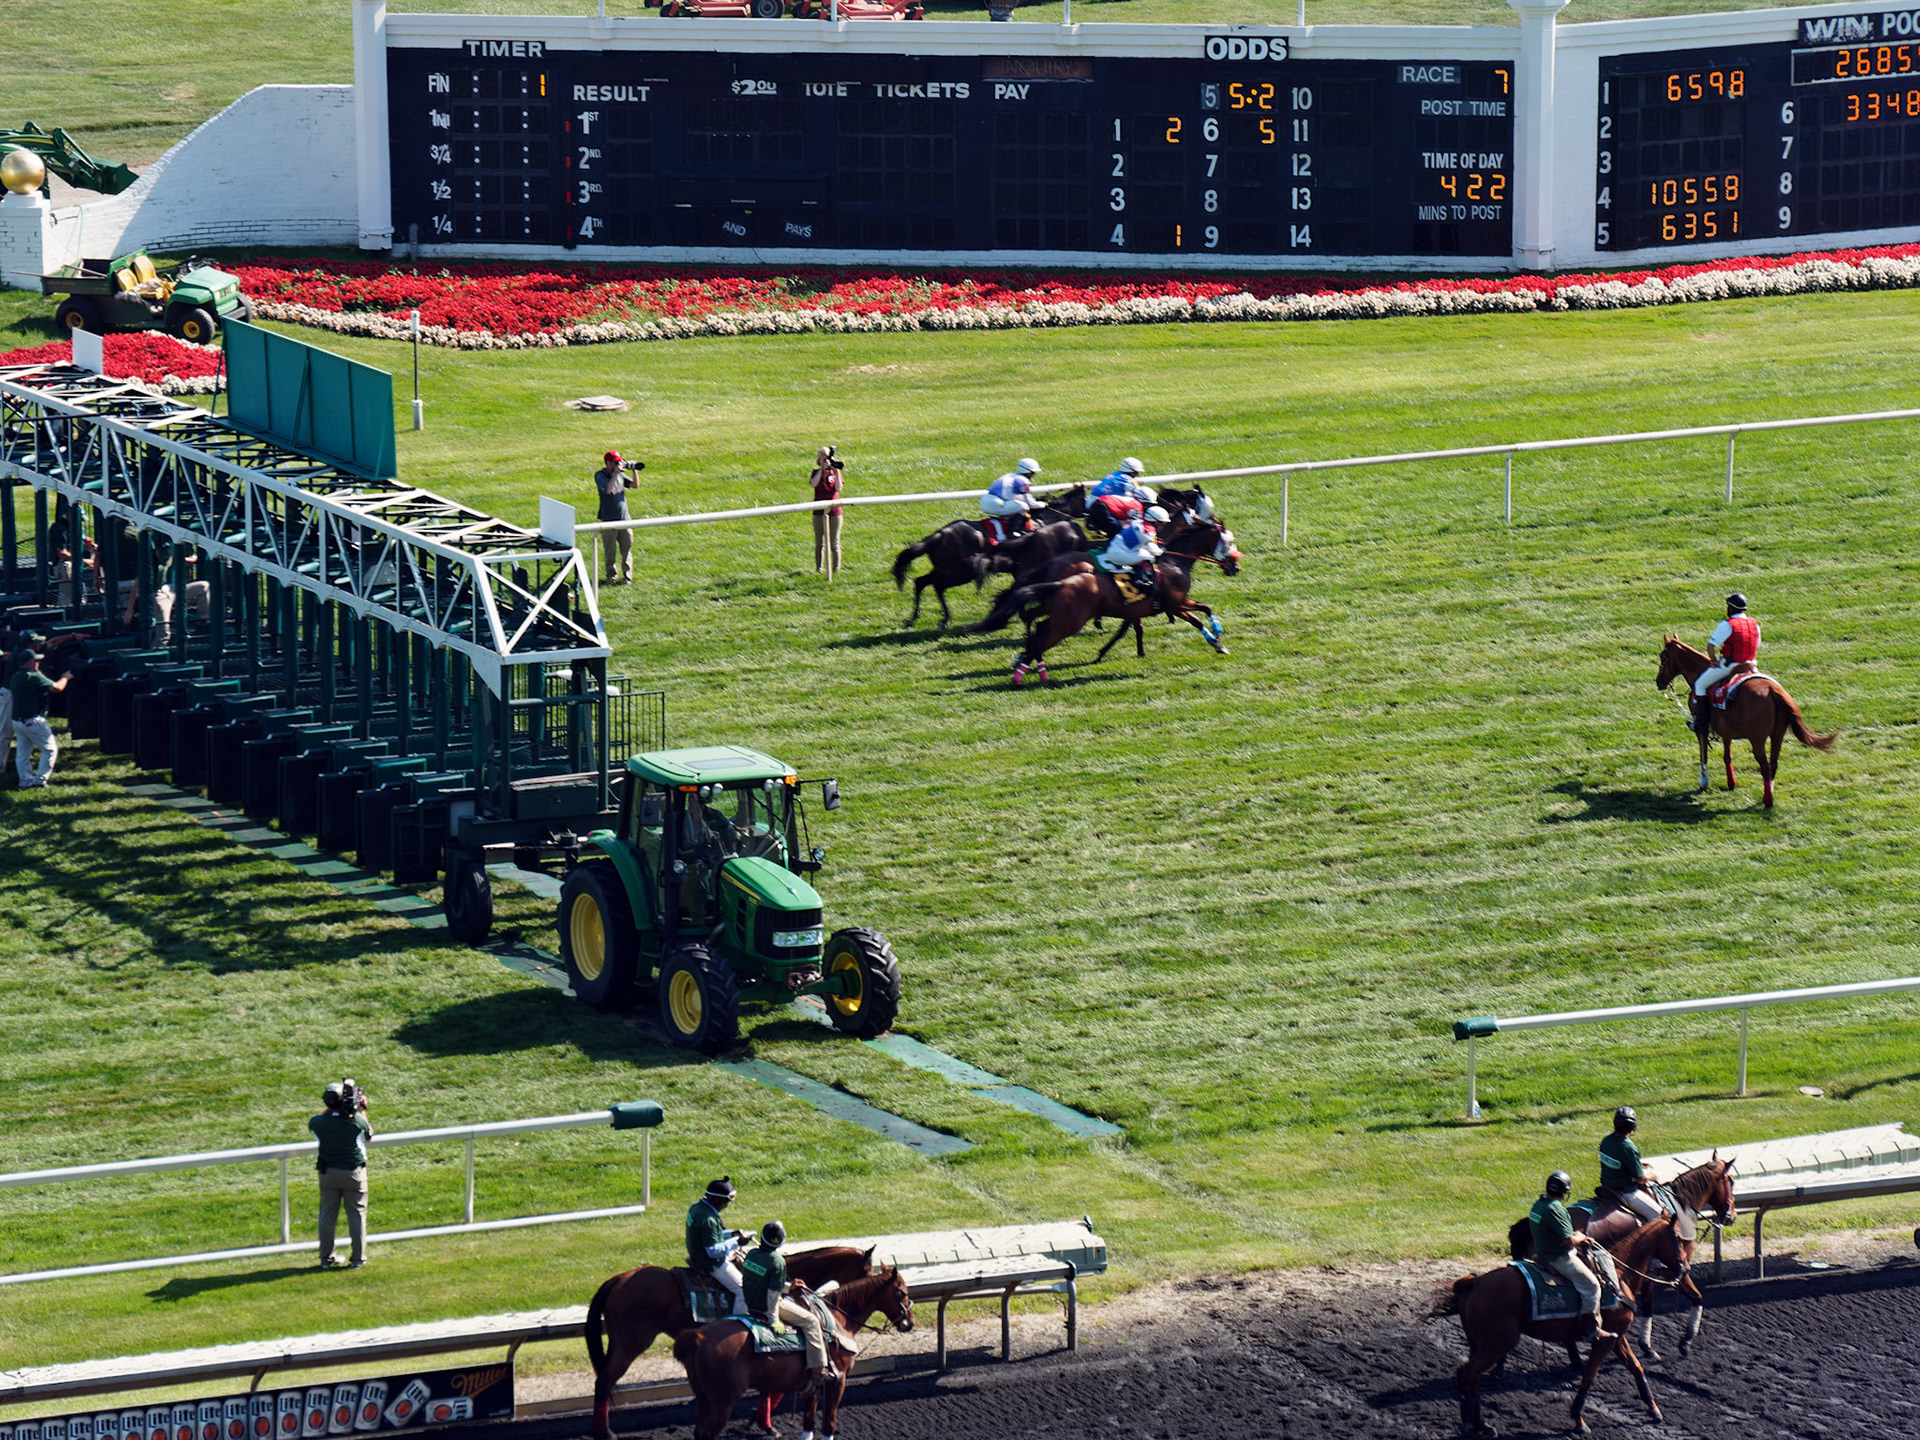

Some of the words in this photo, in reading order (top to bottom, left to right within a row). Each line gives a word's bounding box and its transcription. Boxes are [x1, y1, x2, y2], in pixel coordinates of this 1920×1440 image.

[1805, 15, 1870, 38] WIN
[466, 40, 543, 57] TIMER
[1206, 38, 1287, 61] ODDS
[1836, 46, 1920, 76] 2685
[429, 73, 449, 92] FIN
[1403, 67, 1454, 82] RACE
[1496, 70, 1508, 93] 7
[1604, 82, 1609, 104] 1
[1668, 71, 1744, 101] 6598
[574, 85, 650, 101] RESULT
[873, 83, 969, 98] TICKETS
[995, 84, 1029, 99] PAY
[1205, 85, 1217, 107] 5
[1292, 87, 1312, 109] 10
[1422, 100, 1462, 115] POST
[1470, 101, 1505, 116] TIME
[1782, 102, 1793, 123] 6
[1114, 119, 1120, 141] 1
[1167, 117, 1181, 142] 2
[1204, 118, 1218, 141] 6
[1260, 120, 1274, 143] 5
[1293, 119, 1308, 141] 11
[1600, 117, 1611, 139] 2
[1782, 137, 1793, 159] 7
[1112, 154, 1123, 176] 2
[1206, 155, 1218, 177] 7
[1292, 154, 1311, 176] 12
[1422, 153, 1457, 168] TIME
[1460, 153, 1476, 168] OF
[1479, 153, 1503, 168] DAY
[1600, 151, 1611, 173] 3
[431, 180, 451, 200] 1/2
[1598, 186, 1611, 209] 4
[1652, 176, 1738, 205] 10558
[1780, 172, 1792, 194] 8
[1111, 188, 1125, 211] 3
[1205, 190, 1217, 212] 8
[1292, 188, 1311, 209] 13
[1419, 206, 1447, 220] MINS
[1451, 205, 1466, 219] TO
[1472, 205, 1501, 219] POST
[1779, 207, 1790, 228] 9
[432, 215, 452, 234] 1/4
[722, 221, 746, 237] AND
[785, 222, 812, 238] PAYS
[1111, 224, 1124, 245] 4
[1598, 223, 1609, 244] 5
[1663, 212, 1738, 240] 6351
[1205, 226, 1218, 247] 9
[1291, 225, 1311, 247] 14
[450, 1367, 508, 1397] Miller
[307, 1394, 330, 1408] Lite
[335, 1389, 357, 1404] Lite
[363, 1385, 386, 1401] Lite
[405, 1383, 425, 1404] Lite
[200, 1406, 221, 1422] Lite
[225, 1403, 247, 1419] Lite
[250, 1399, 273, 1415] Lite
[279, 1397, 301, 1412] Lite
[454, 1400, 467, 1419] Lite
[96, 1419, 118, 1434] Lite
[122, 1416, 144, 1432] Lite
[148, 1412, 170, 1428] Lite
[174, 1409, 195, 1425] Lite
[43, 1425, 65, 1440] Lite
[70, 1422, 92, 1437] Lite
